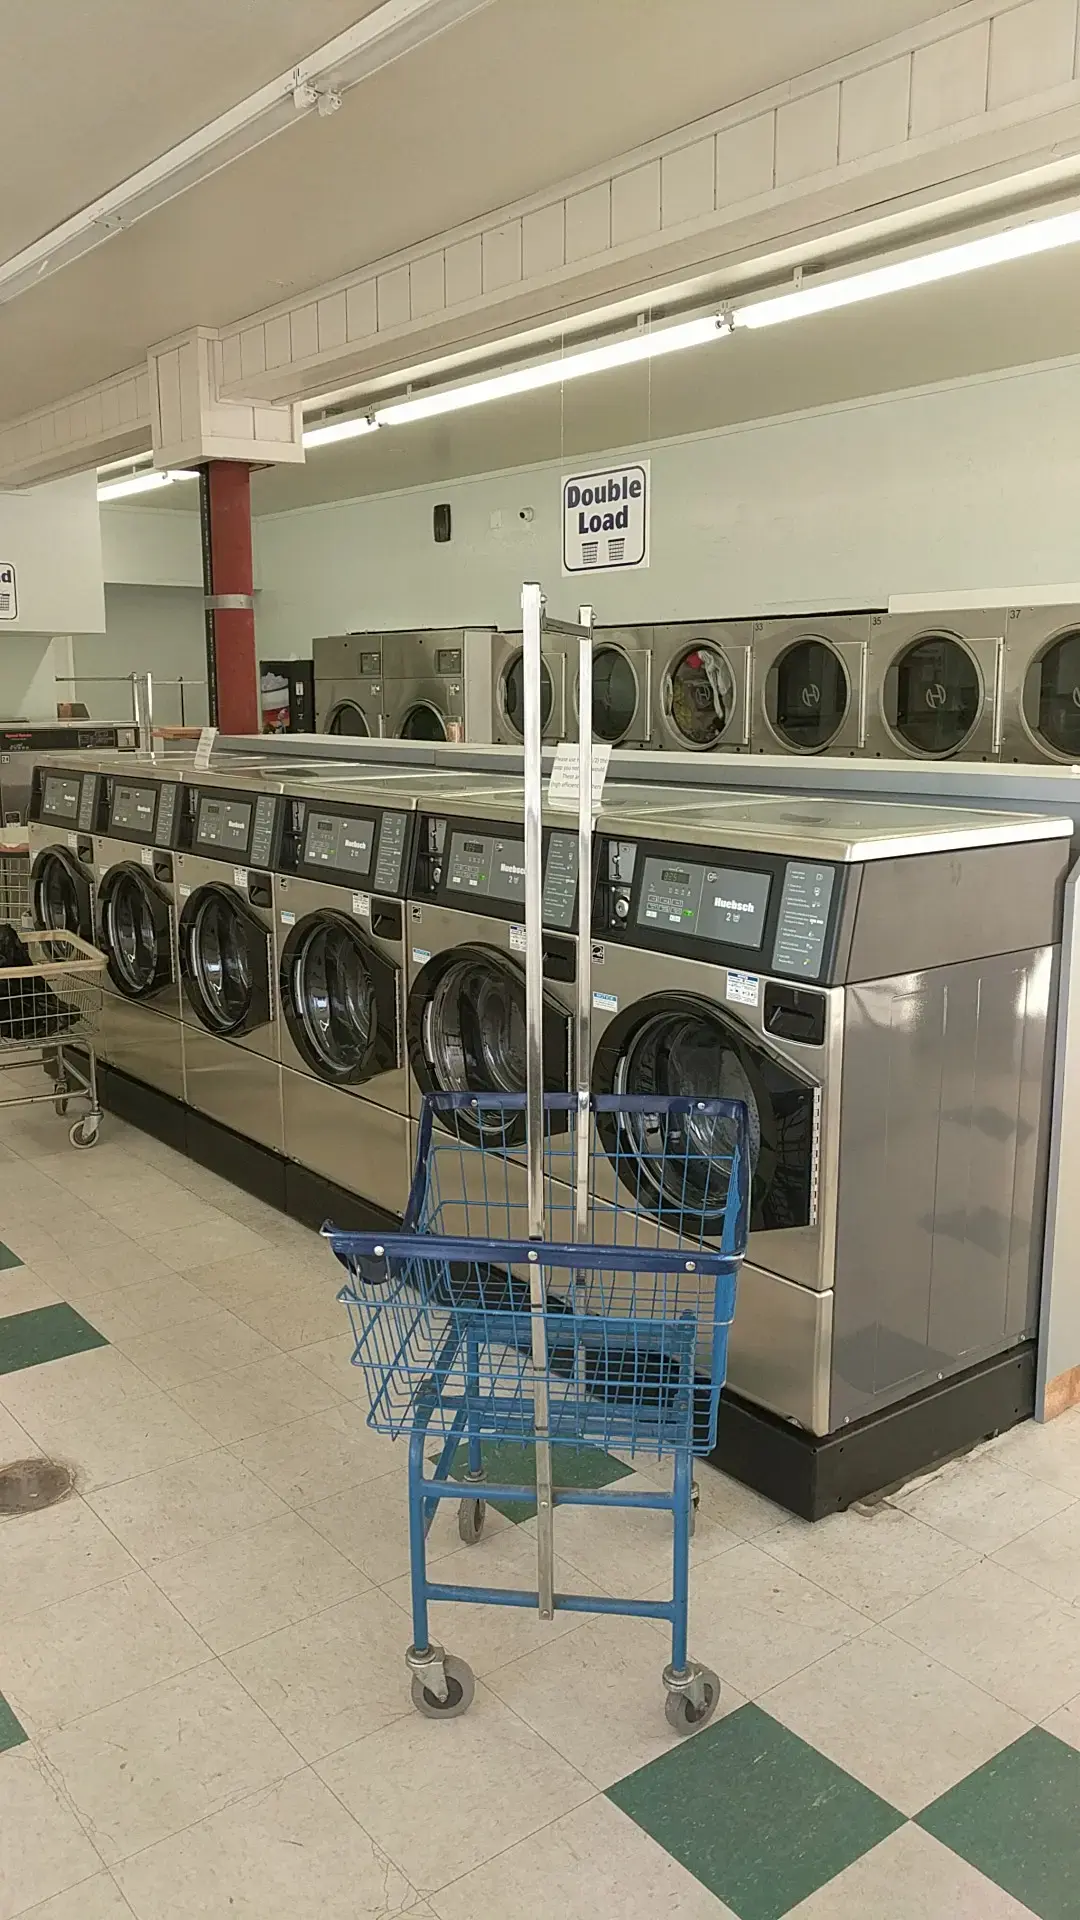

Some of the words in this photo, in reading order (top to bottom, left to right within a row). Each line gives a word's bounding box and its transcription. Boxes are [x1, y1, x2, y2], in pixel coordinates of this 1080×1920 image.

[567, 476, 642, 508] Double
[578, 505, 629, 534] Load
[1009, 609, 1021, 619] 37
[754, 622, 764, 631] 33
[872, 616, 882, 626] 35
[500, 863, 527, 876] Huebsc
[714, 896, 755, 913] Huebsch
[725, 912, 732, 922] 2
